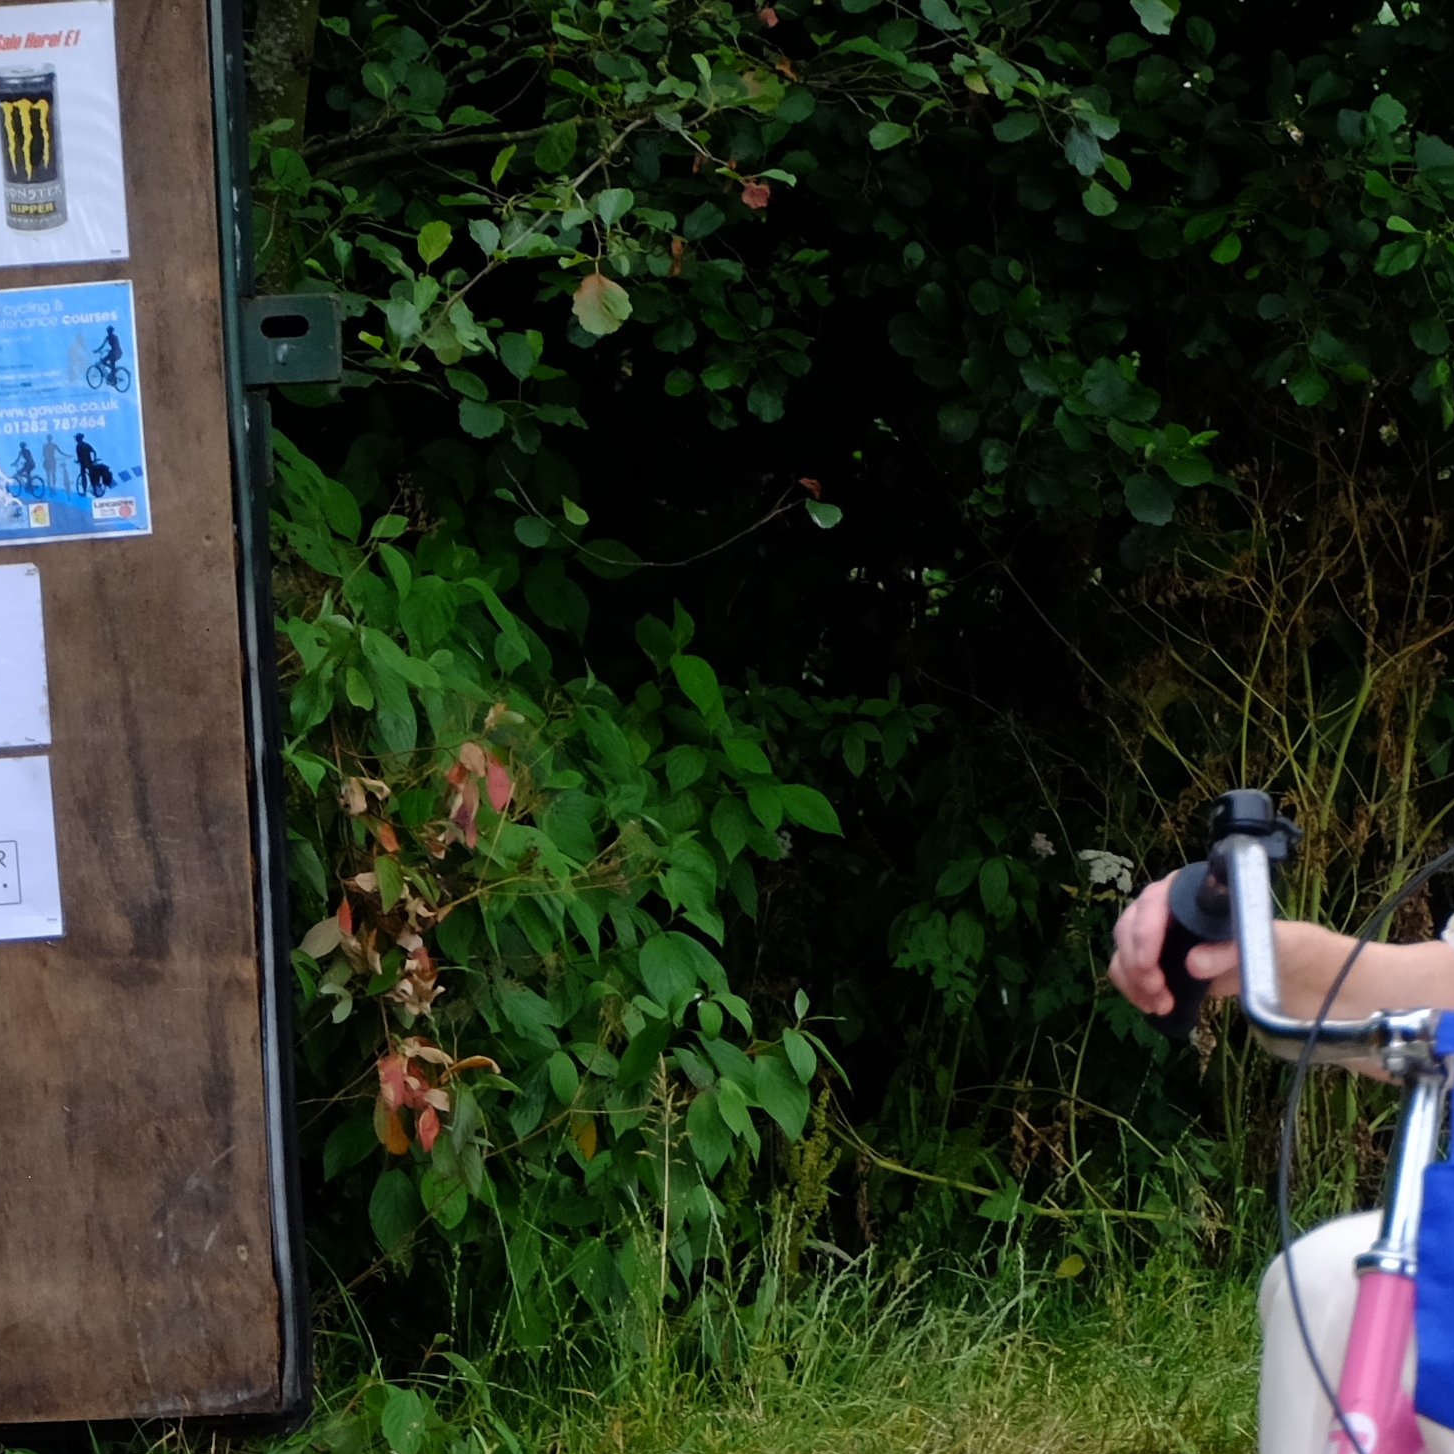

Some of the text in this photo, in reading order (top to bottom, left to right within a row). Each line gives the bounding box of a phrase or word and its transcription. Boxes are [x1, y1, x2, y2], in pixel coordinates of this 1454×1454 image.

[10, 202, 54, 214] RIPPER
[3, 301, 50, 317] cycling
[54, 300, 63, 311] &
[62, 311, 118, 325] courses
